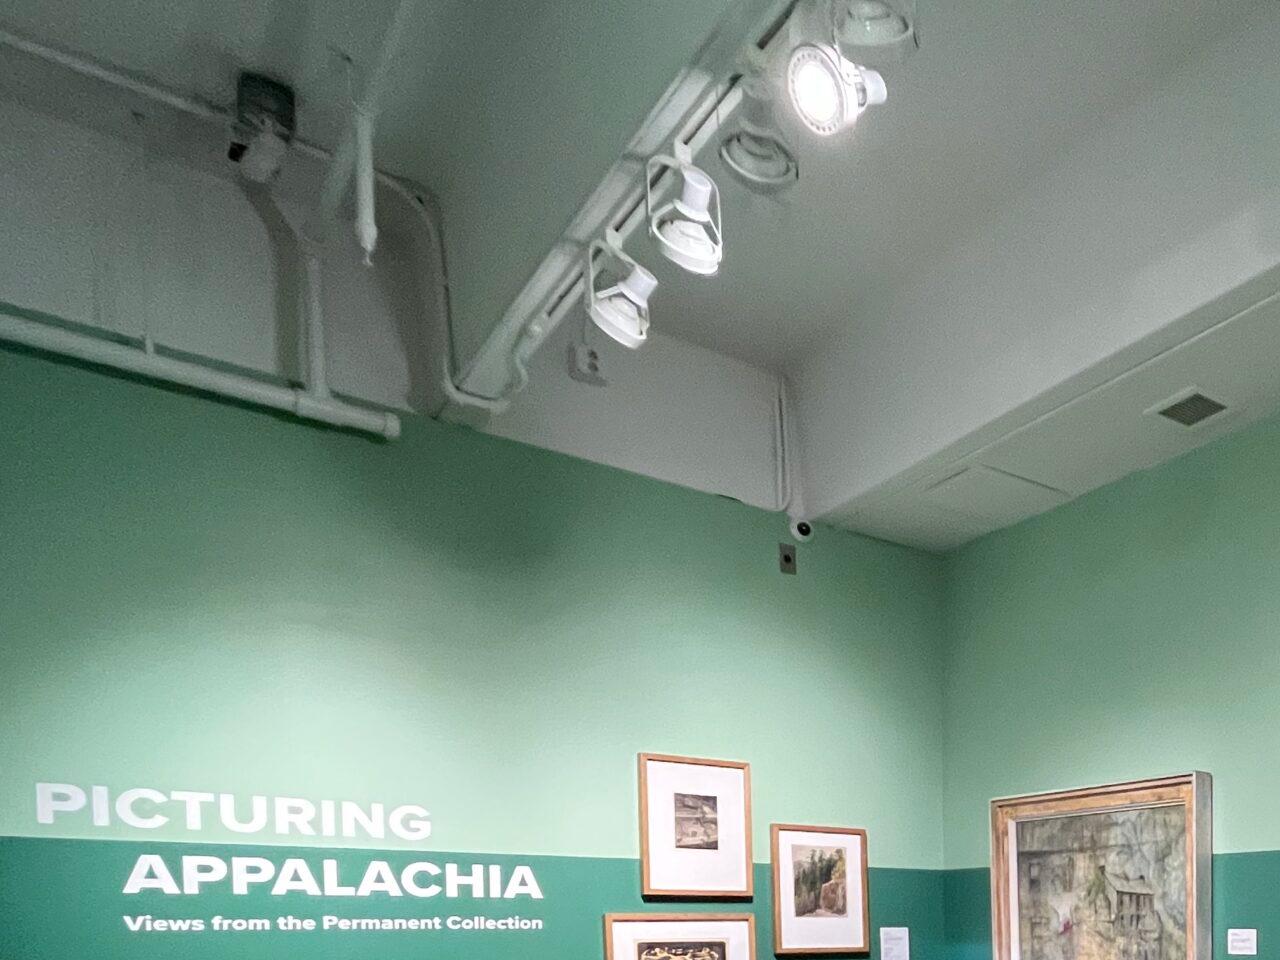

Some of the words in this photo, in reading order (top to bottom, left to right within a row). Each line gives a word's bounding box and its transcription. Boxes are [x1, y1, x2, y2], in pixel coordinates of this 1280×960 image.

[35, 782, 431, 841] PICTURING
[122, 854, 544, 899] APPALACHIA
[123, 915, 205, 931] Views
[212, 915, 270, 931] from
[277, 915, 316, 931] the
[322, 915, 441, 930] Permanent
[447, 915, 543, 930] Collection
